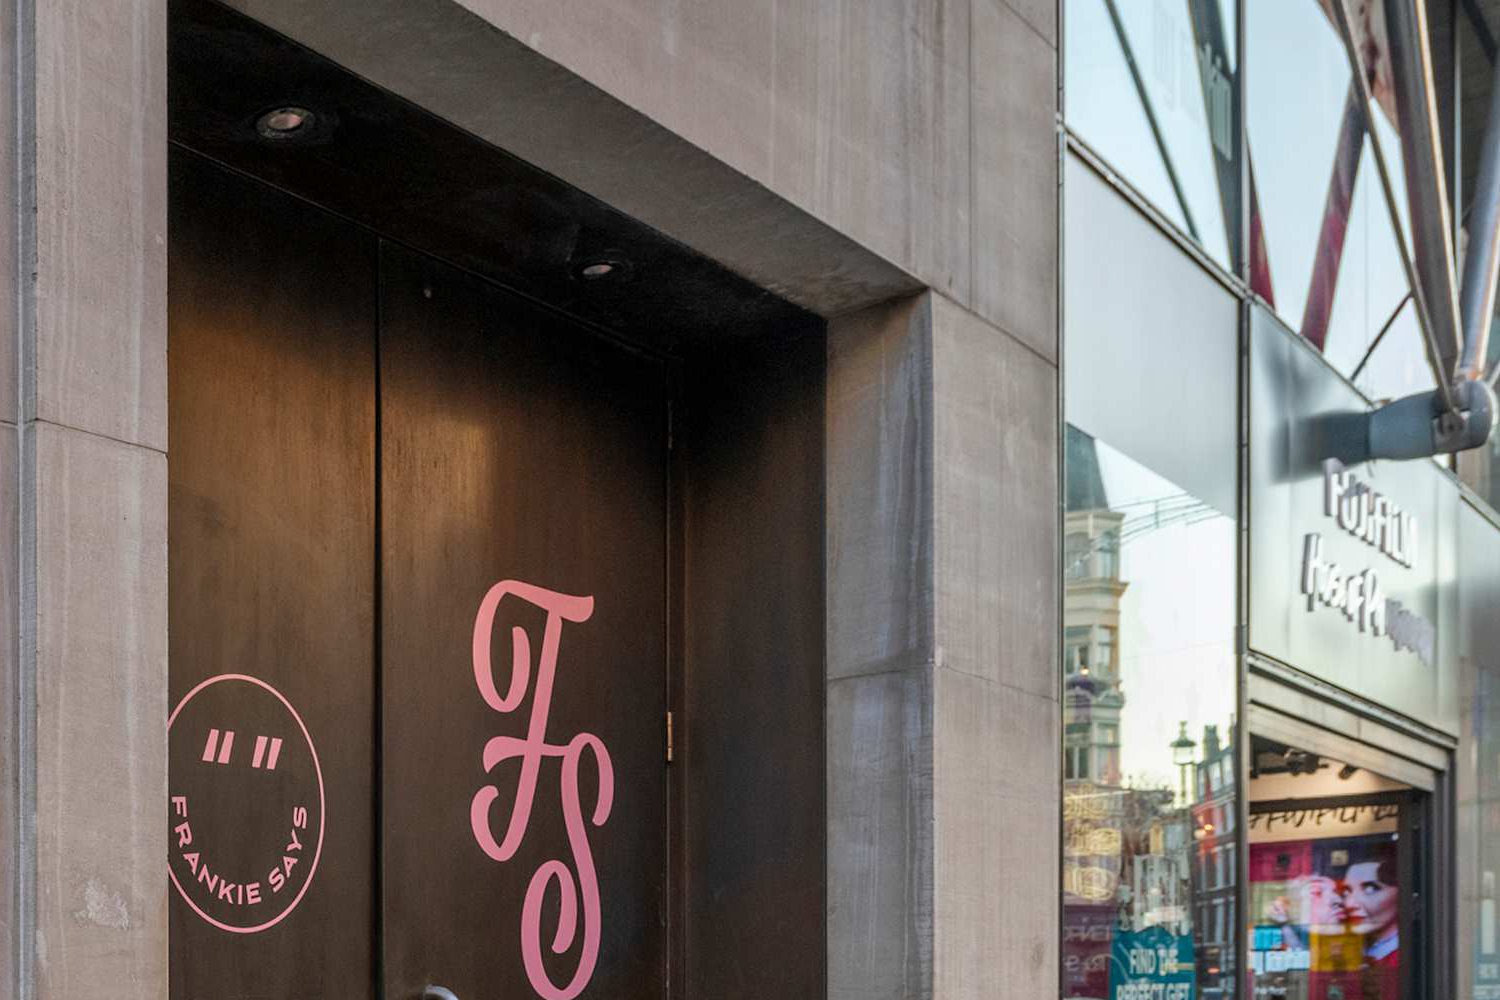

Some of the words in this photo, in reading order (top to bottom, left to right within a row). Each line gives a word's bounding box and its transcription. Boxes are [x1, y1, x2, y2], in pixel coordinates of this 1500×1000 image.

[172, 796, 262, 905] FRANKIE
[268, 807, 308, 893] SAYS
[1130, 948, 1156, 975] FIND
